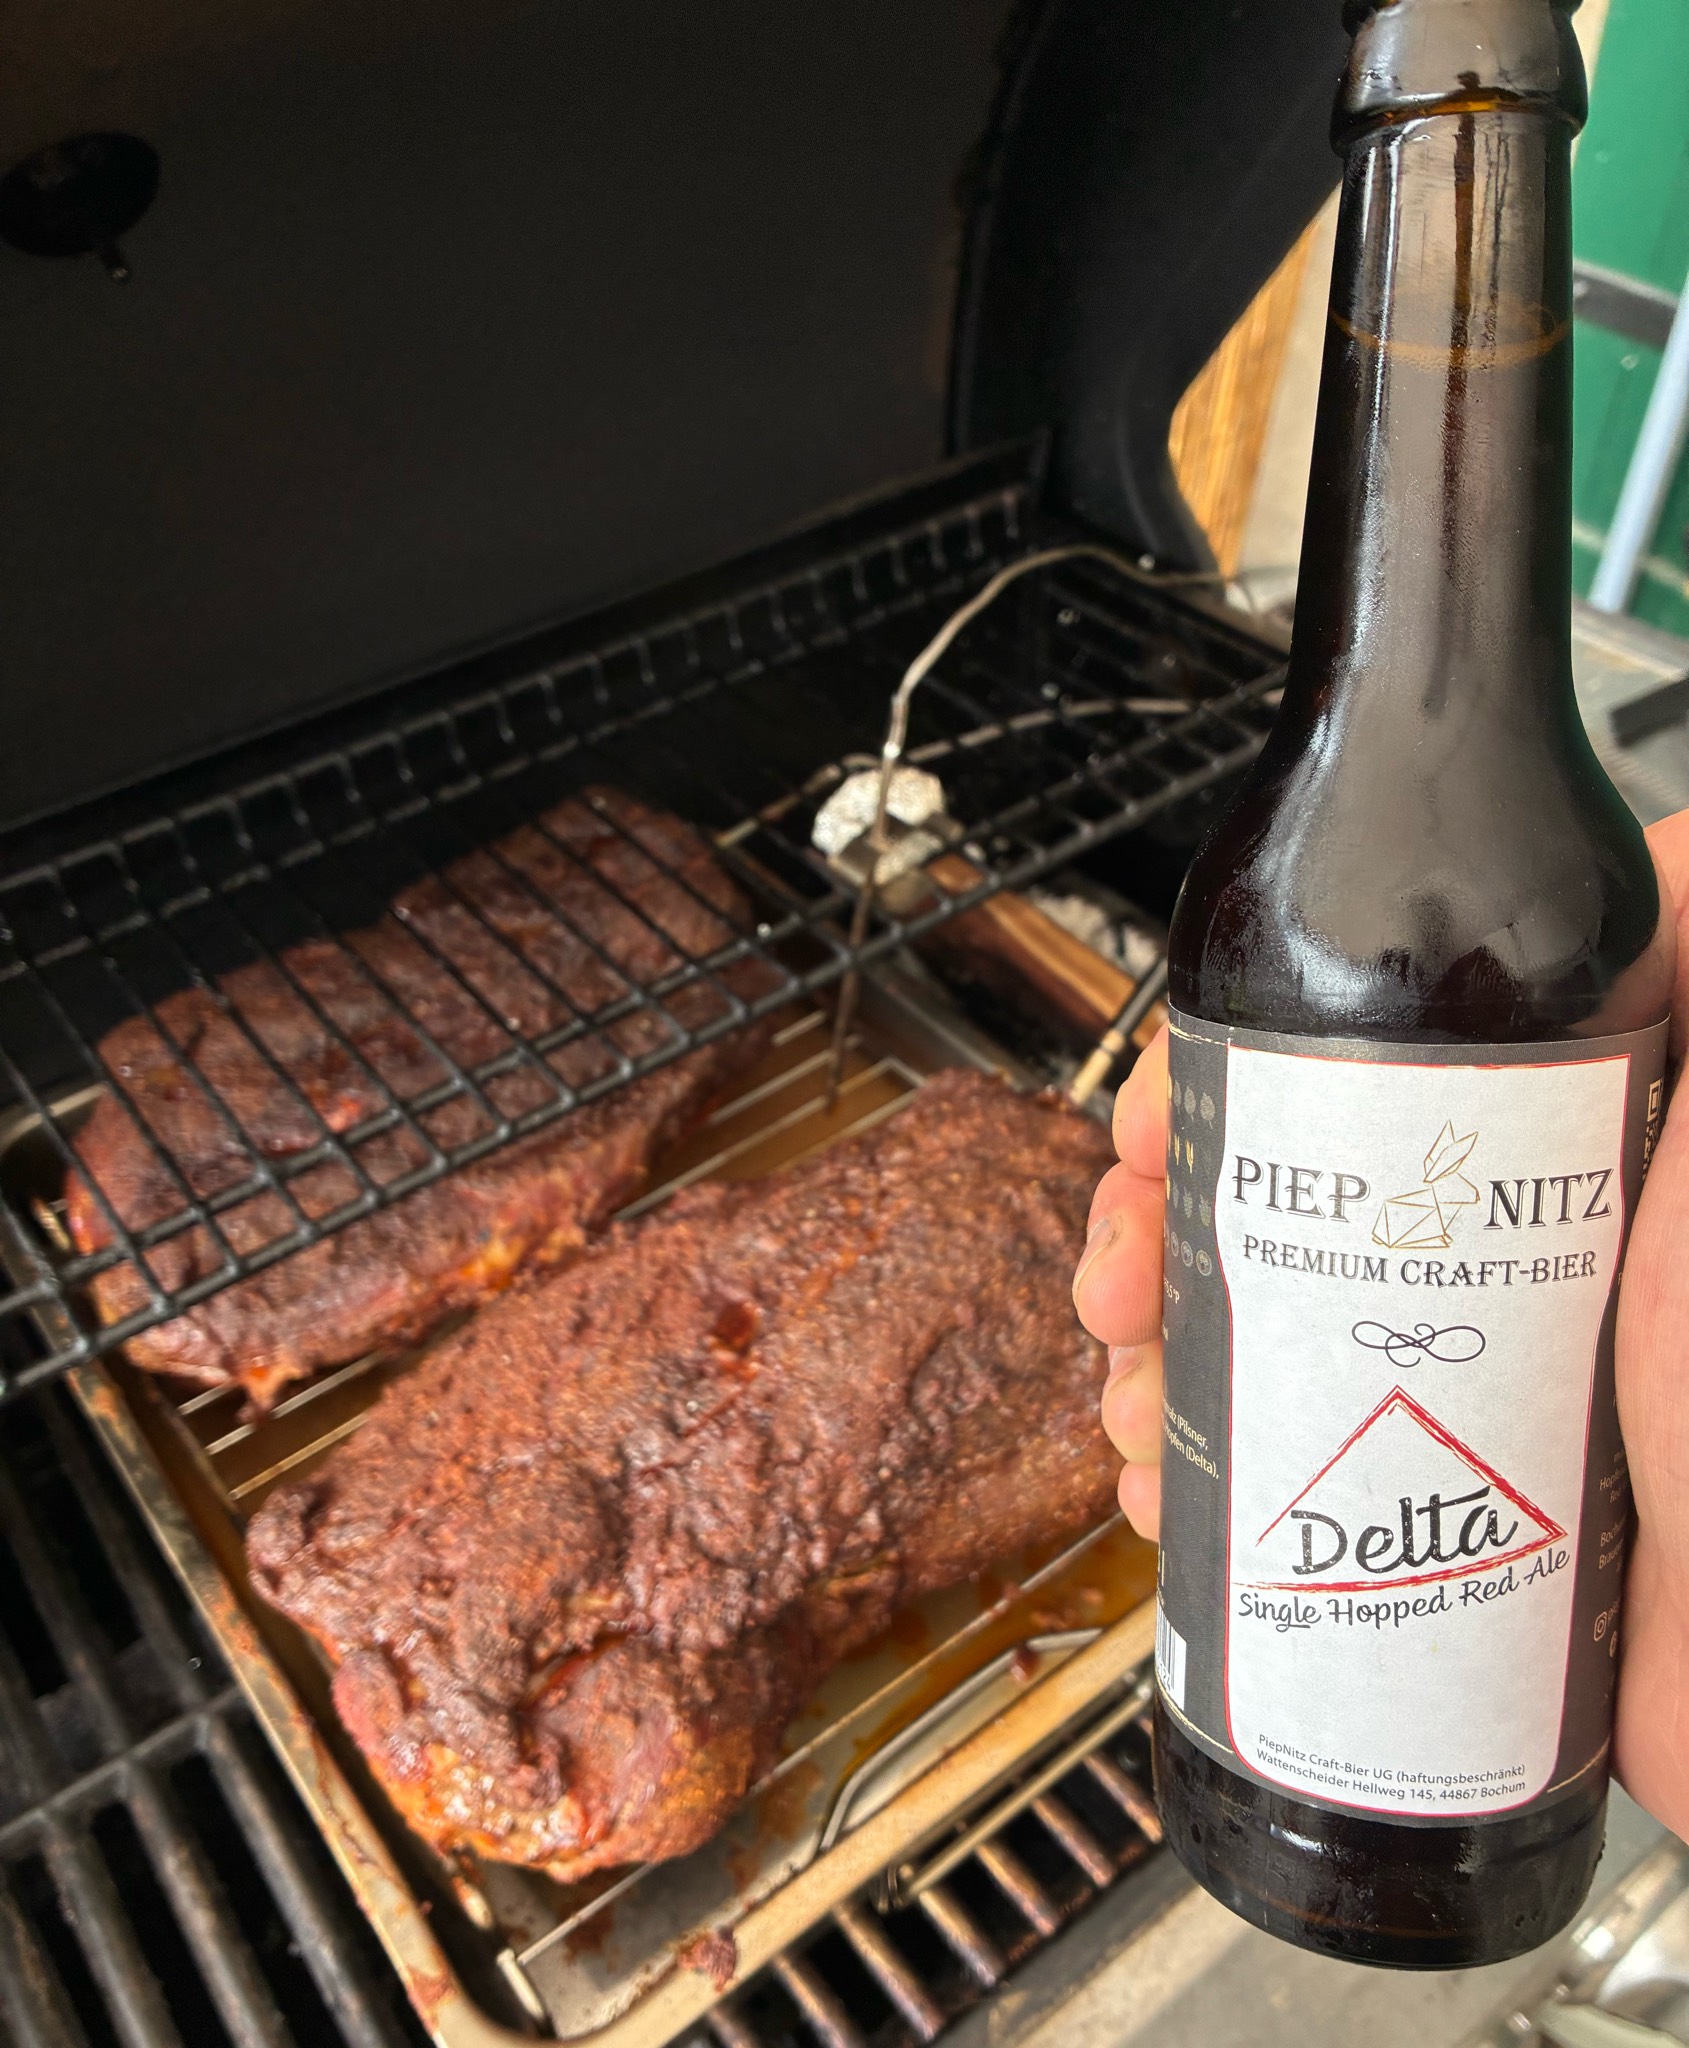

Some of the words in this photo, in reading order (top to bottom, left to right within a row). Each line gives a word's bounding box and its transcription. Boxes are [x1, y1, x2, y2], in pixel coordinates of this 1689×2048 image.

[1232, 1155, 1370, 1223] PIEP
[1483, 1168, 1614, 1230] NITZ
[1243, 1234, 1389, 1283] PREMIUM
[1401, 1251, 1597, 1288] CRAFT-BIER
[1177, 1414, 1208, 1451] (Pilsner,
[1186, 1444, 1219, 1480] (Delta),
[1290, 1486, 1520, 1576] Delta
[1238, 1593, 1321, 1632] Single
[1329, 1586, 1452, 1630] Hopped
[1459, 1565, 1521, 1607] Red
[1524, 1547, 1570, 1586] Ale
[1256, 1748, 1350, 1788] Wattenscheider
[1352, 1779, 1405, 1800] Hellweg
[1410, 1788, 1436, 1801] 145,
[1439, 1788, 1478, 1800] 44867
[1480, 1781, 1526, 1798] Bochum
[1259, 1734, 1307, 1761] PiepNitz
[1308, 1754, 1370, 1777] Craft-Bier
[1373, 1768, 1393, 1780] UG
[1396, 1764, 1525, 1787] (haftungsbeschränkt)
